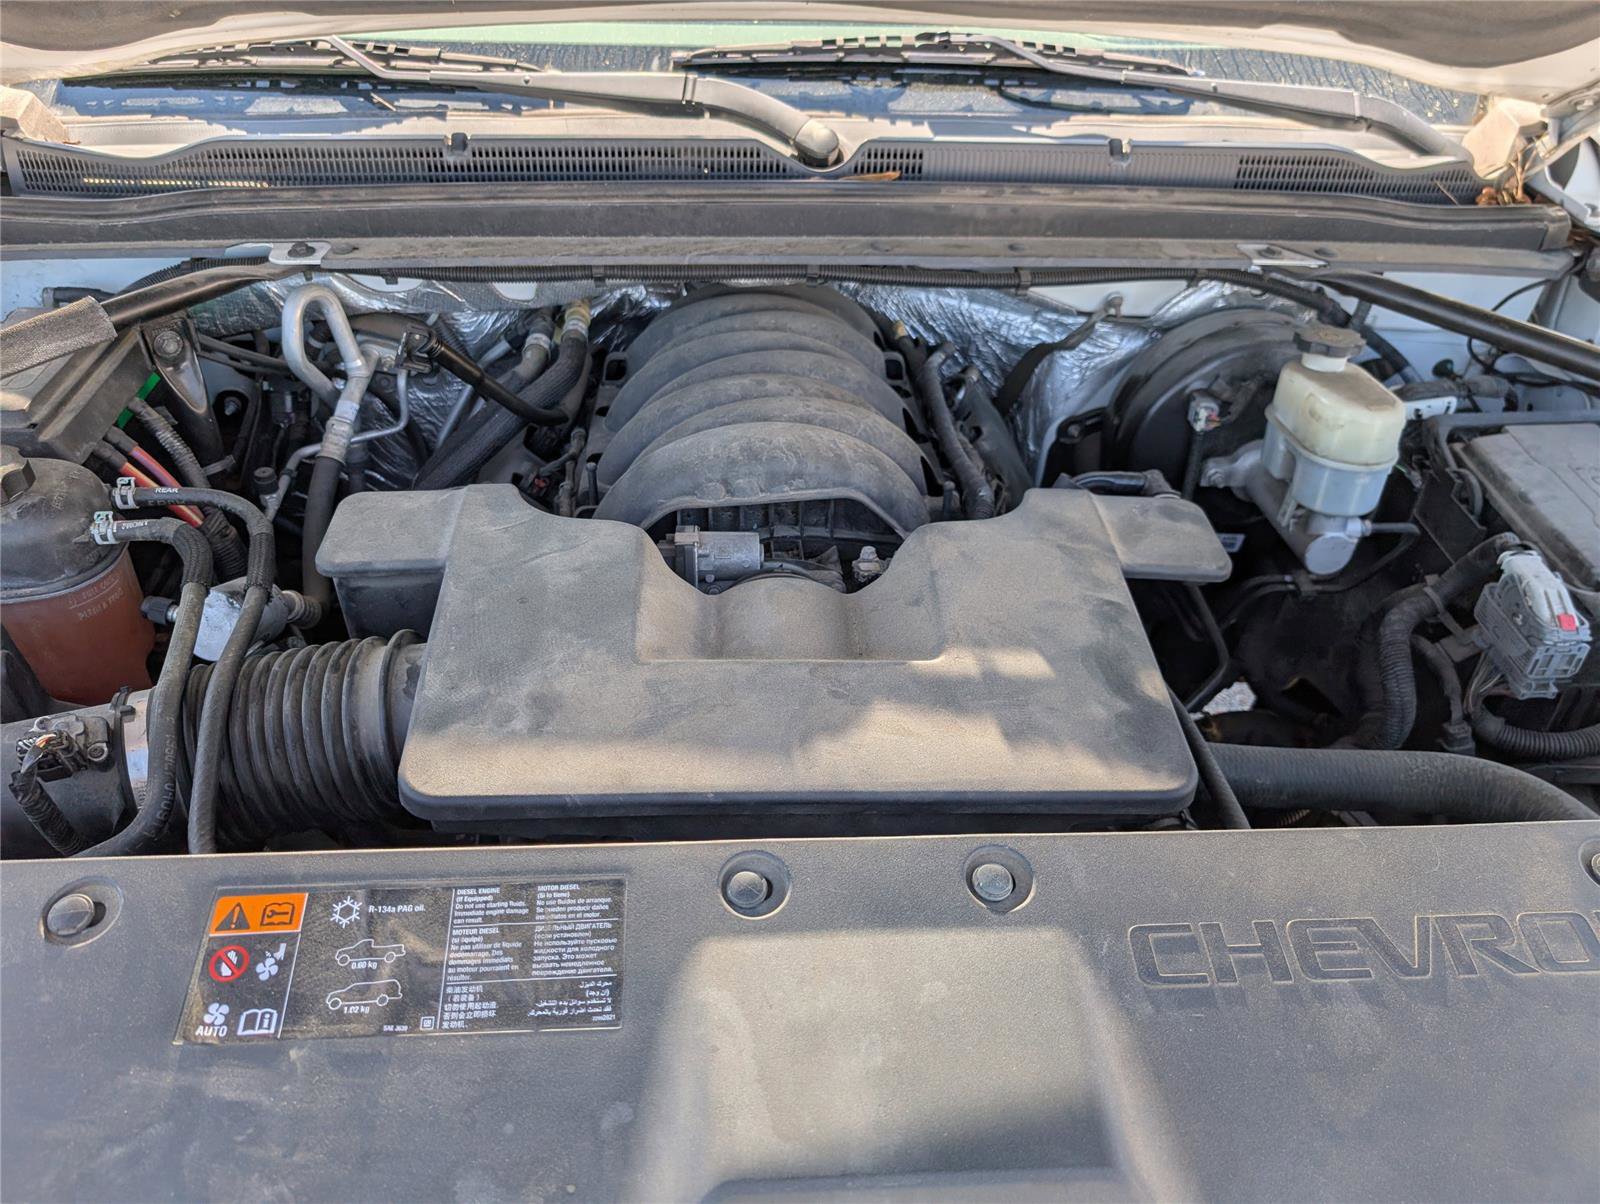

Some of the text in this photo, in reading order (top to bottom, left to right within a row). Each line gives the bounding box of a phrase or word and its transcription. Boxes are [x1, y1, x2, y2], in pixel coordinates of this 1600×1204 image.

[368, 904, 396, 912] R-134a
[396, 904, 413, 912] PAG
[486, 908, 505, 916] engine
[575, 922, 612, 930] ДВИГАТЕЛЬ
[452, 928, 478, 936] MOTEUR
[1128, 910, 1600, 986] CHEVRO
[368, 960, 378, 970] kg
[448, 958, 482, 966] dommages
[360, 1005, 370, 1014] kg
[195, 1025, 228, 1037] AUTO
